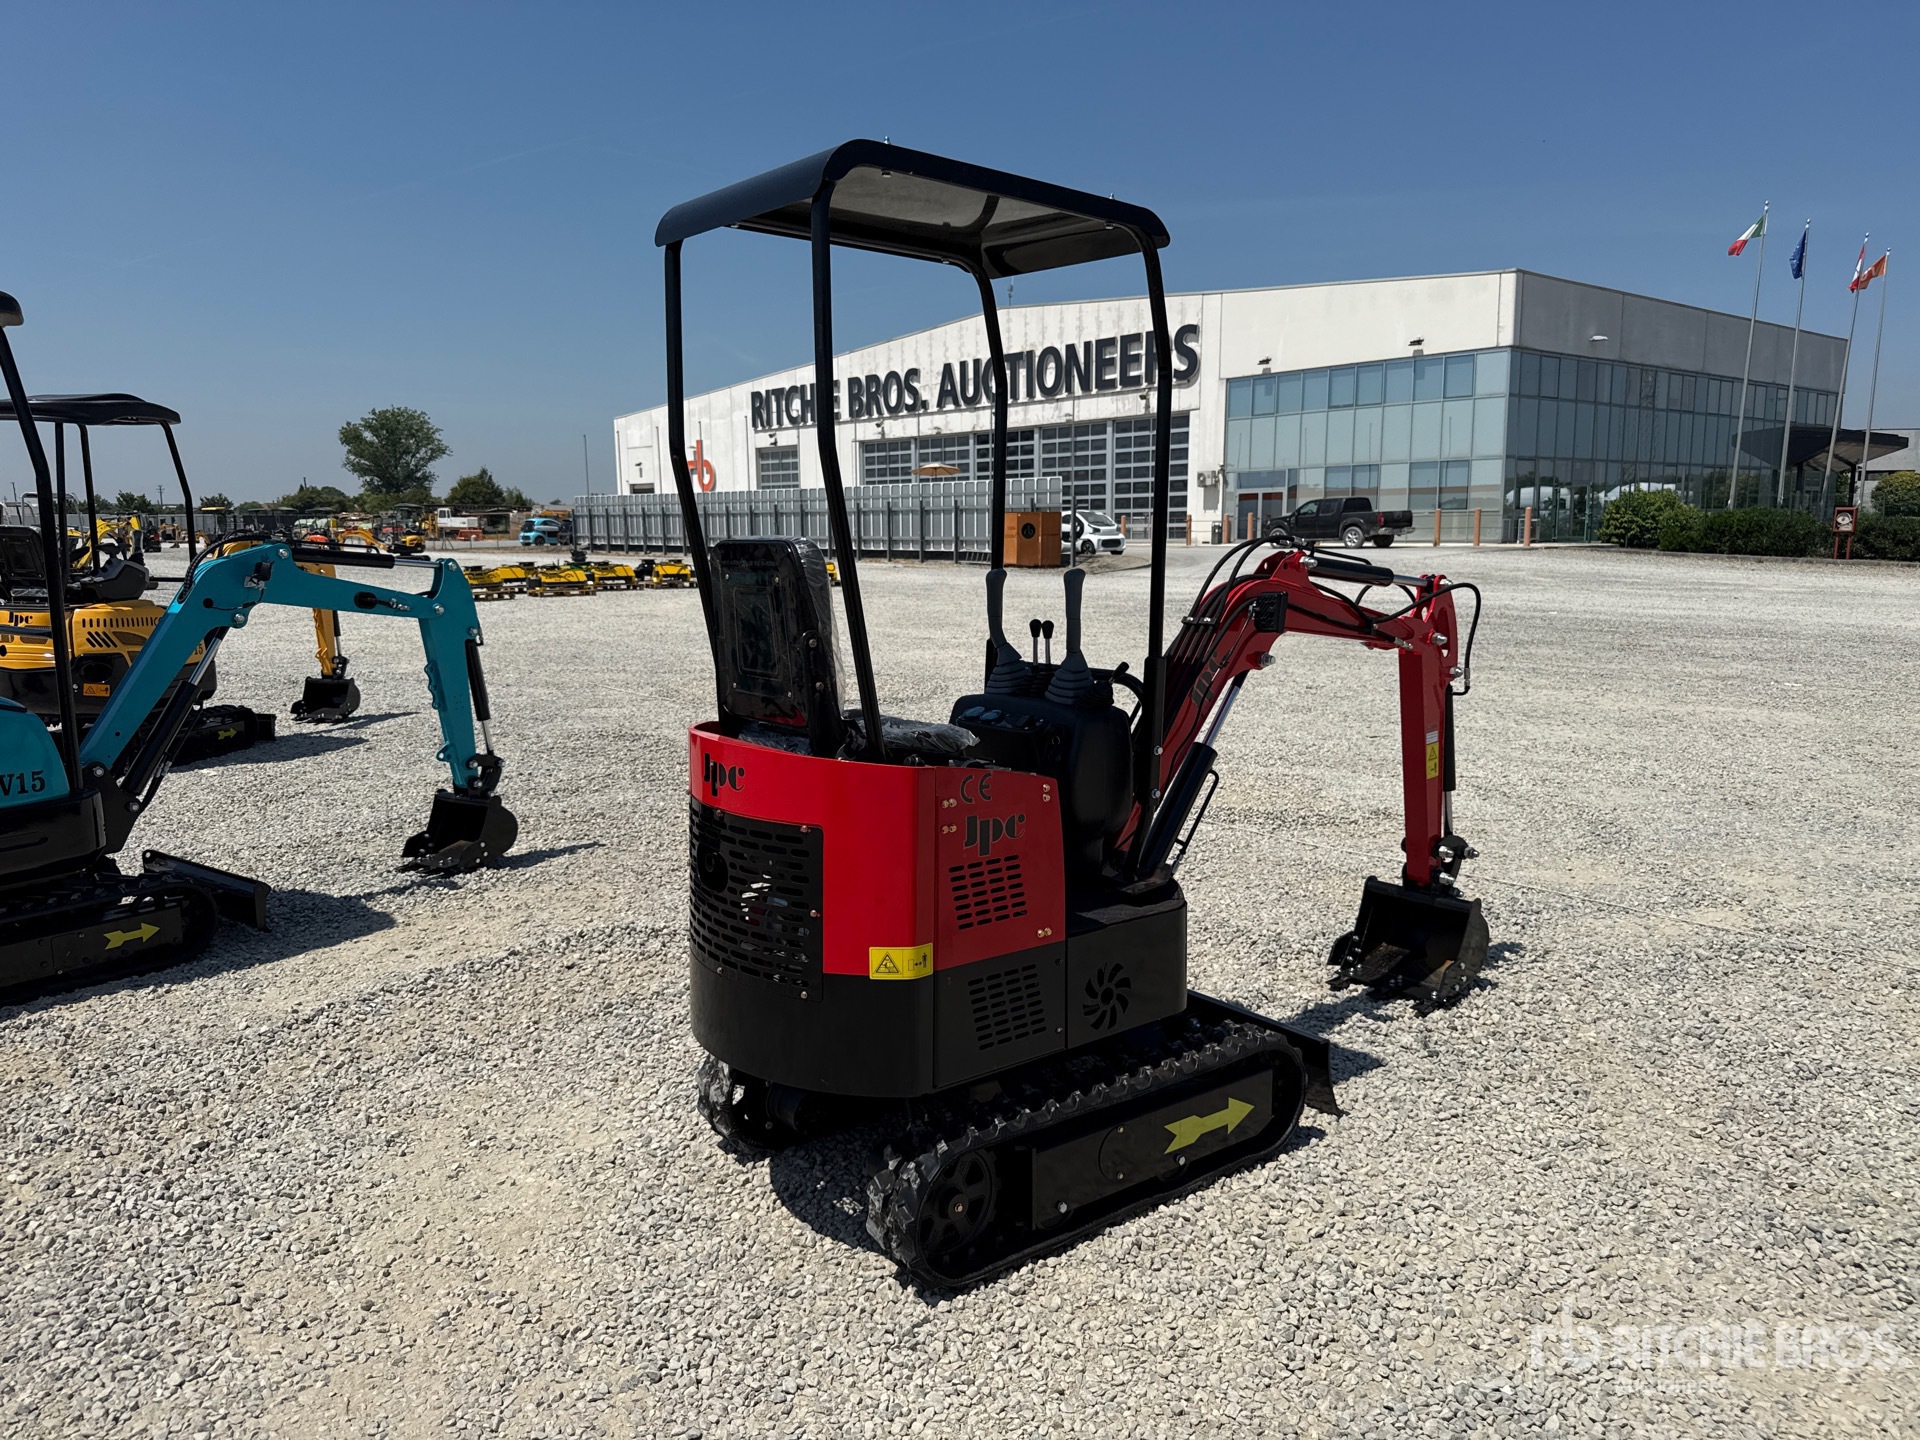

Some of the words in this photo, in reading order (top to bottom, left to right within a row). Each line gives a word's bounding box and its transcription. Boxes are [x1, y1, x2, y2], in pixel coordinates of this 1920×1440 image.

[751, 380, 841, 429] RITCHE
[847, 367, 930, 419] BROS.
[960, 772, 992, 804] CE
